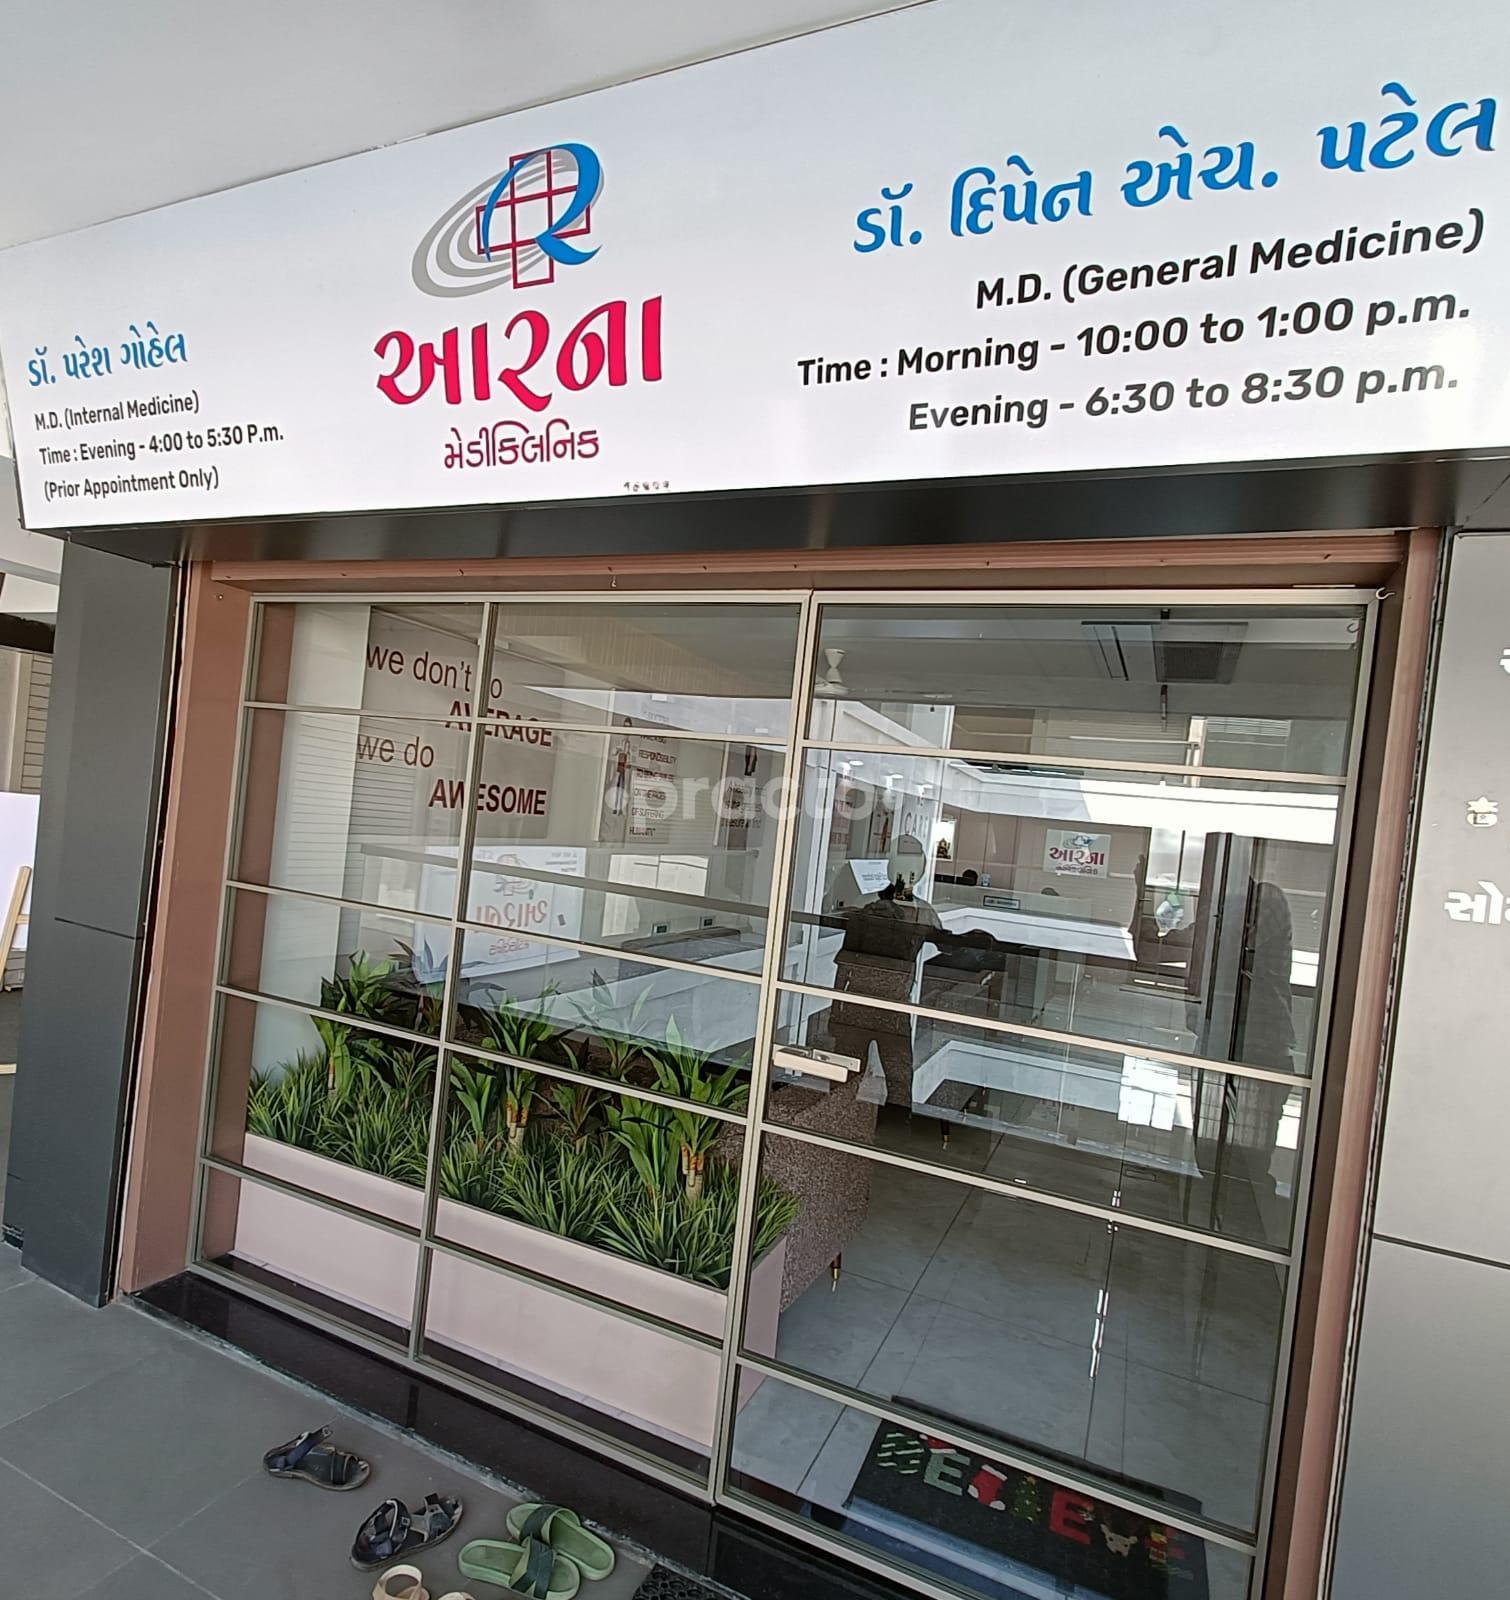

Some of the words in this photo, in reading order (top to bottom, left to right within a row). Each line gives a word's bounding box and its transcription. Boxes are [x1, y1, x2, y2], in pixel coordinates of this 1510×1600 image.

[950, 154, 1093, 237] દિપેન
[1120, 125, 1279, 208] એચ.
[1316, 81, 1497, 173] પટેલ
[976, 273, 1052, 310] M.D.
[1063, 244, 1238, 304] (General
[1249, 207, 1485, 274] Medicine)
[63, 335, 113, 379] પરેશ
[120, 320, 188, 370] ગોહેલ
[372, 295, 663, 412] આરના
[897, 338, 1039, 376] Morning
[1076, 316, 1188, 357] 10:00
[1199, 313, 1244, 344] to
[1257, 297, 1354, 338] 1:00
[1365, 294, 1470, 336] p.m.
[34, 411, 63, 431] M.D.
[64, 401, 124, 430] (Internal
[126, 389, 200, 420] Medicine)
[909, 394, 1048, 431] Evening
[1085, 378, 1175, 417] 6:30
[1185, 377, 1229, 408] to
[1241, 365, 1344, 405] 8:30
[1356, 364, 1458, 404] p.m.
[79, 440, 136, 461] Evening
[148, 432, 184, 454] 4:00
[185, 430, 204, 449] to
[206, 426, 244, 448] 5:30
[247, 423, 285, 444] P.m.
[44, 480, 80, 502] (Prior
[83, 470, 176, 499] Appointment
[178, 465, 220, 491] Only)
[367, 646, 404, 675] we
[413, 651, 472, 692] don't
[445, 700, 552, 748] AERAGE
[357, 735, 395, 763] we
[404, 736, 434, 768] do
